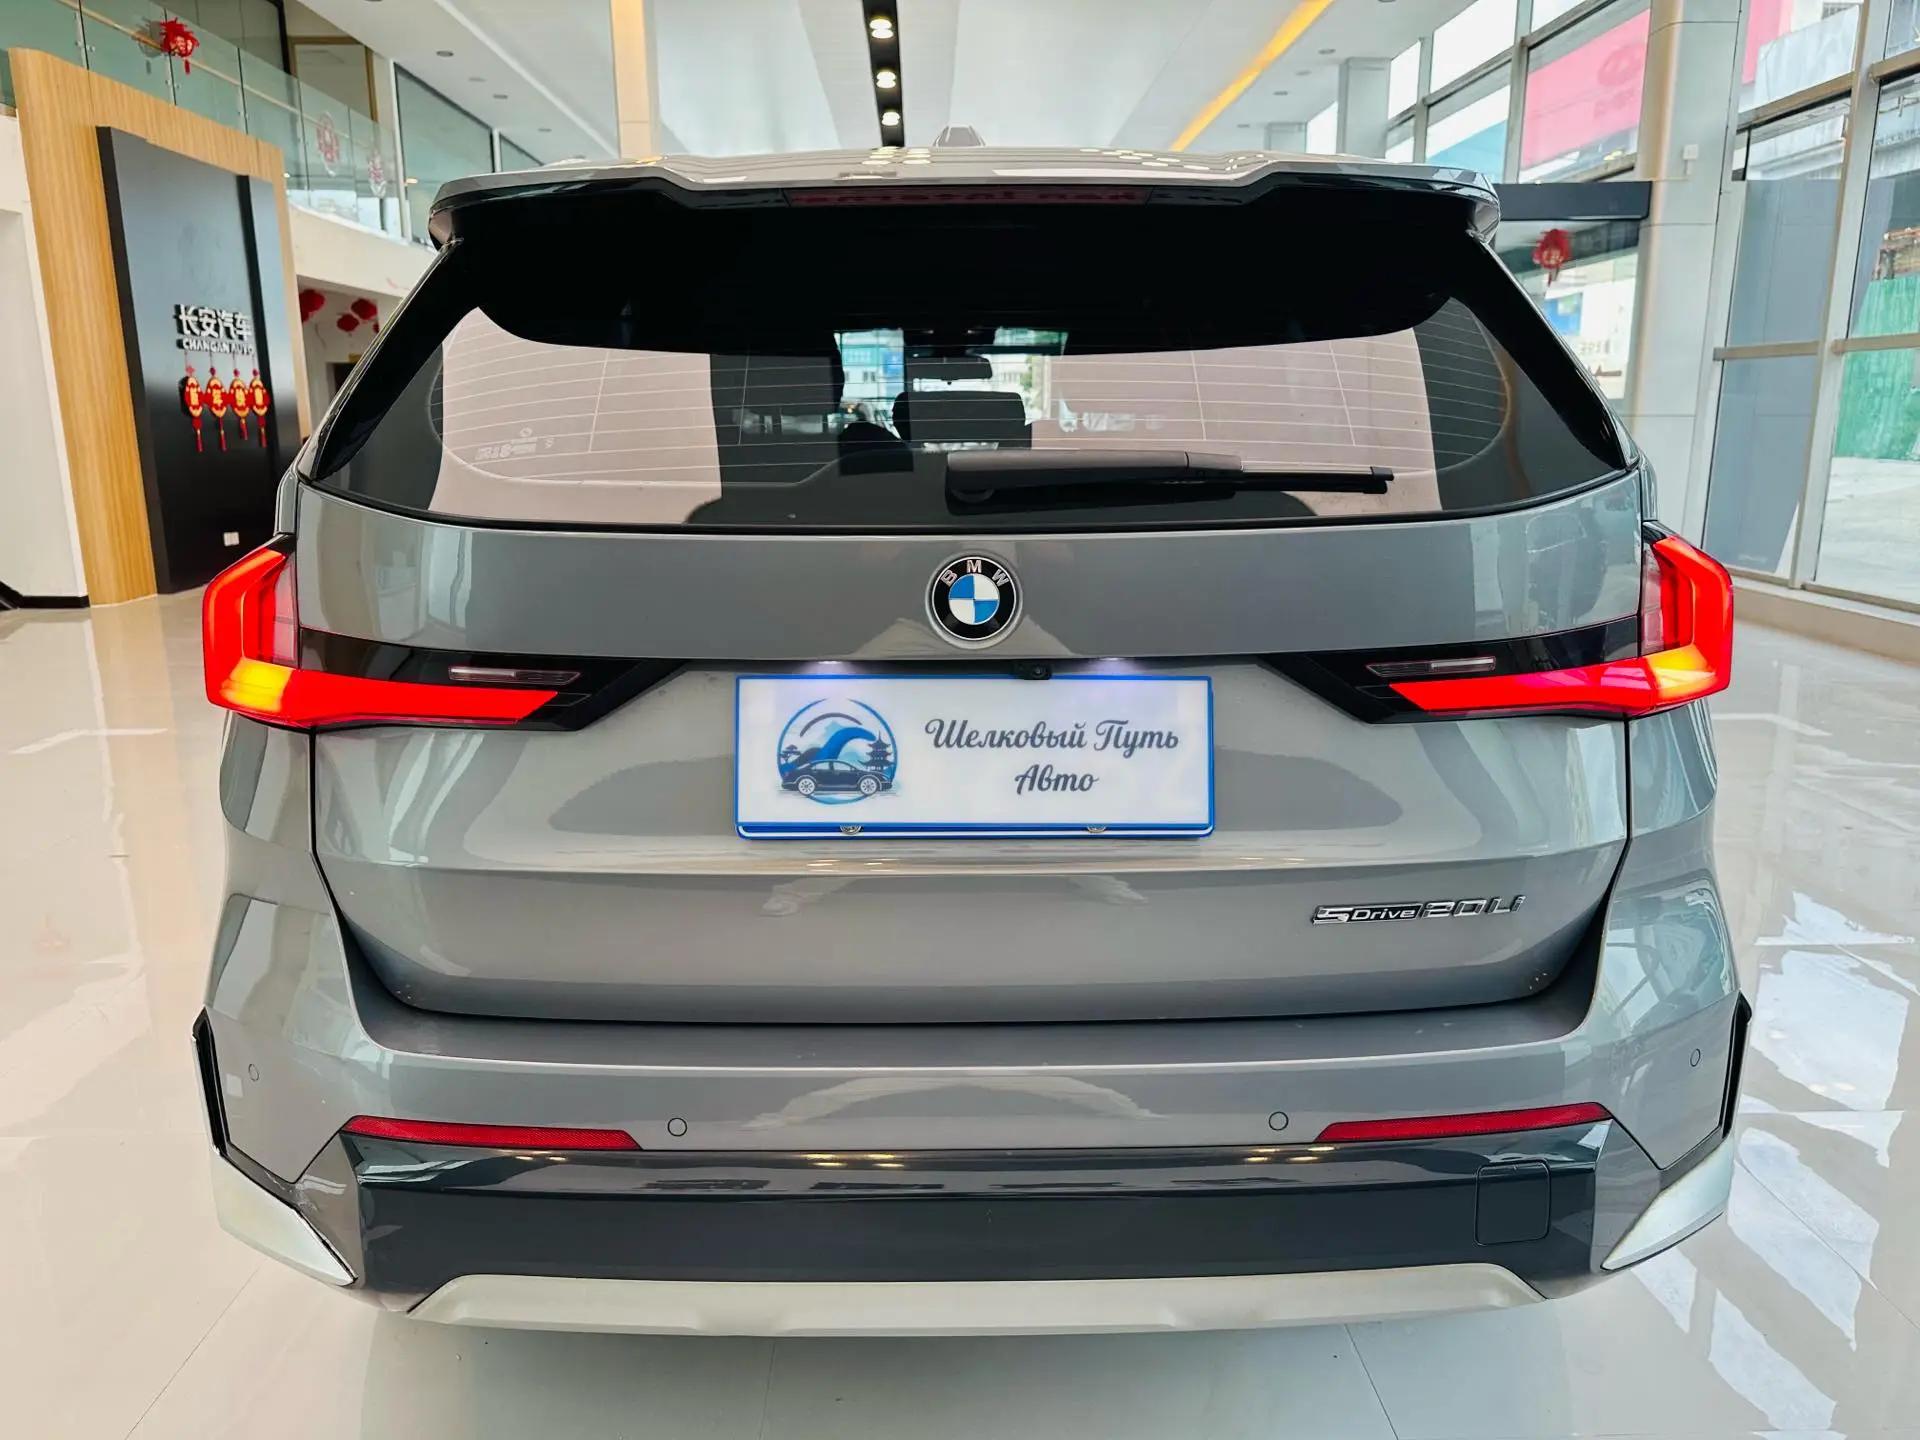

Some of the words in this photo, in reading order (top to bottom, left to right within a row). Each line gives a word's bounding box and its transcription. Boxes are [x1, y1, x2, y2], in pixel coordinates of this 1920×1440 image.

[178, 303, 253, 341] 长安汽车
[182, 338, 231, 354] CHANGAN
[940, 559, 1010, 587] BMW
[924, 718, 1088, 750] Шелковый
[1093, 719, 1179, 758] Путь
[1014, 764, 1100, 796] Авто
